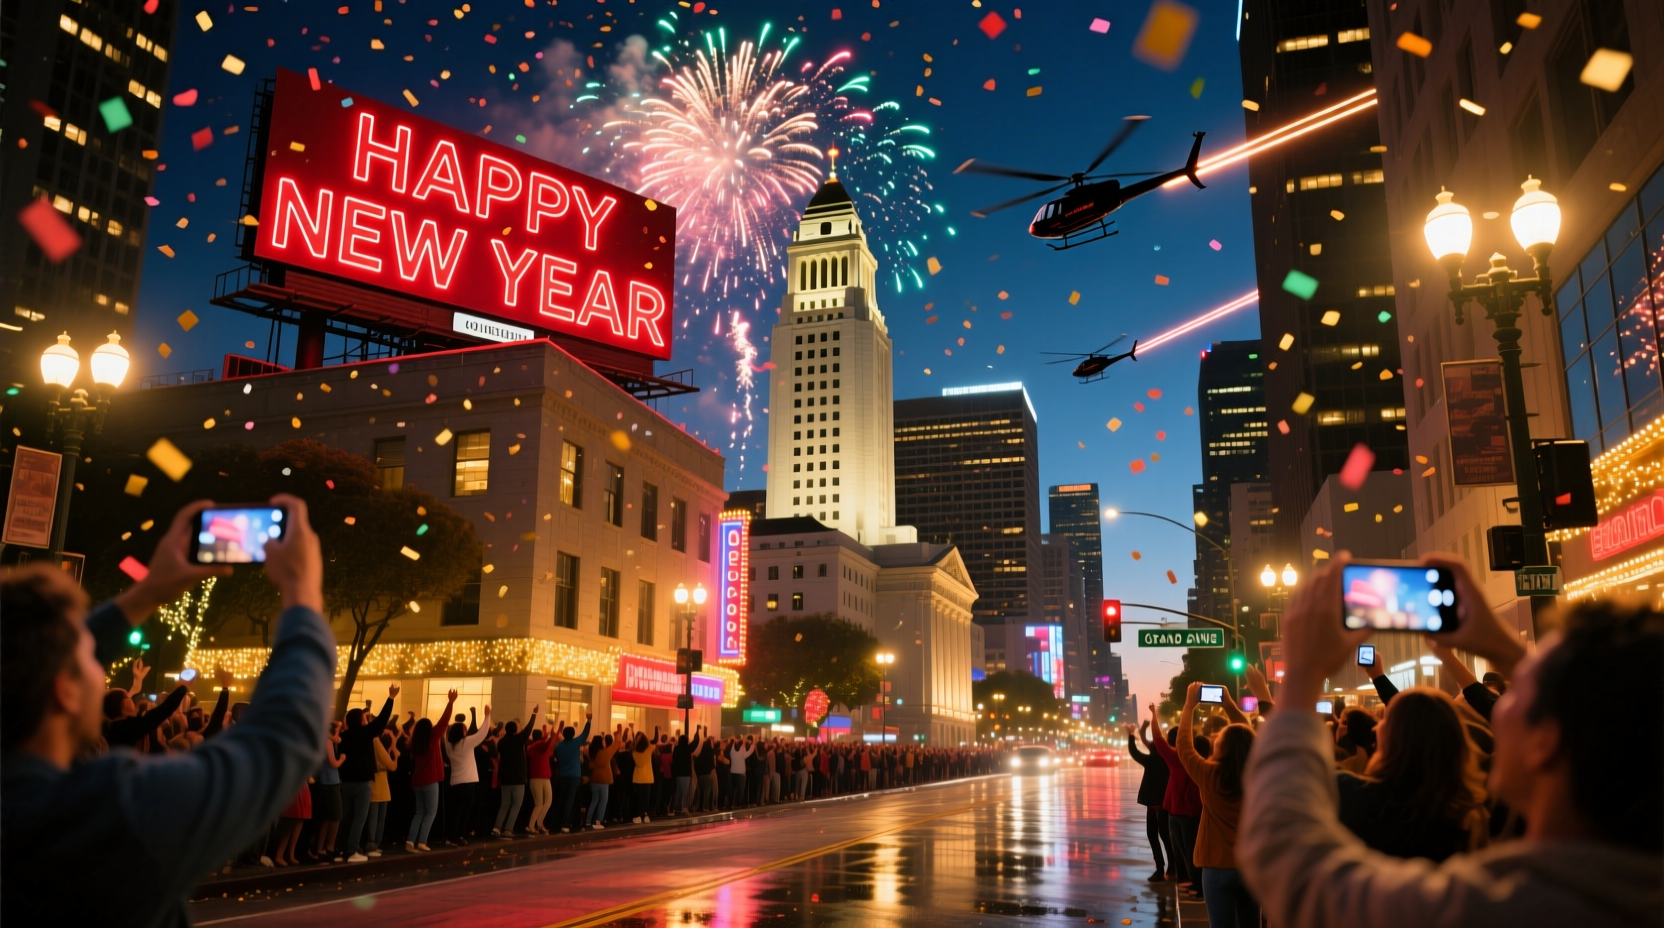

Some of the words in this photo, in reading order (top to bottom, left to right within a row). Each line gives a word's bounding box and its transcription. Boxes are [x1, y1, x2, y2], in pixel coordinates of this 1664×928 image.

[353, 112, 617, 250] HAPPY
[272, 177, 468, 289] NEW
[491, 238, 665, 347] YEAR
